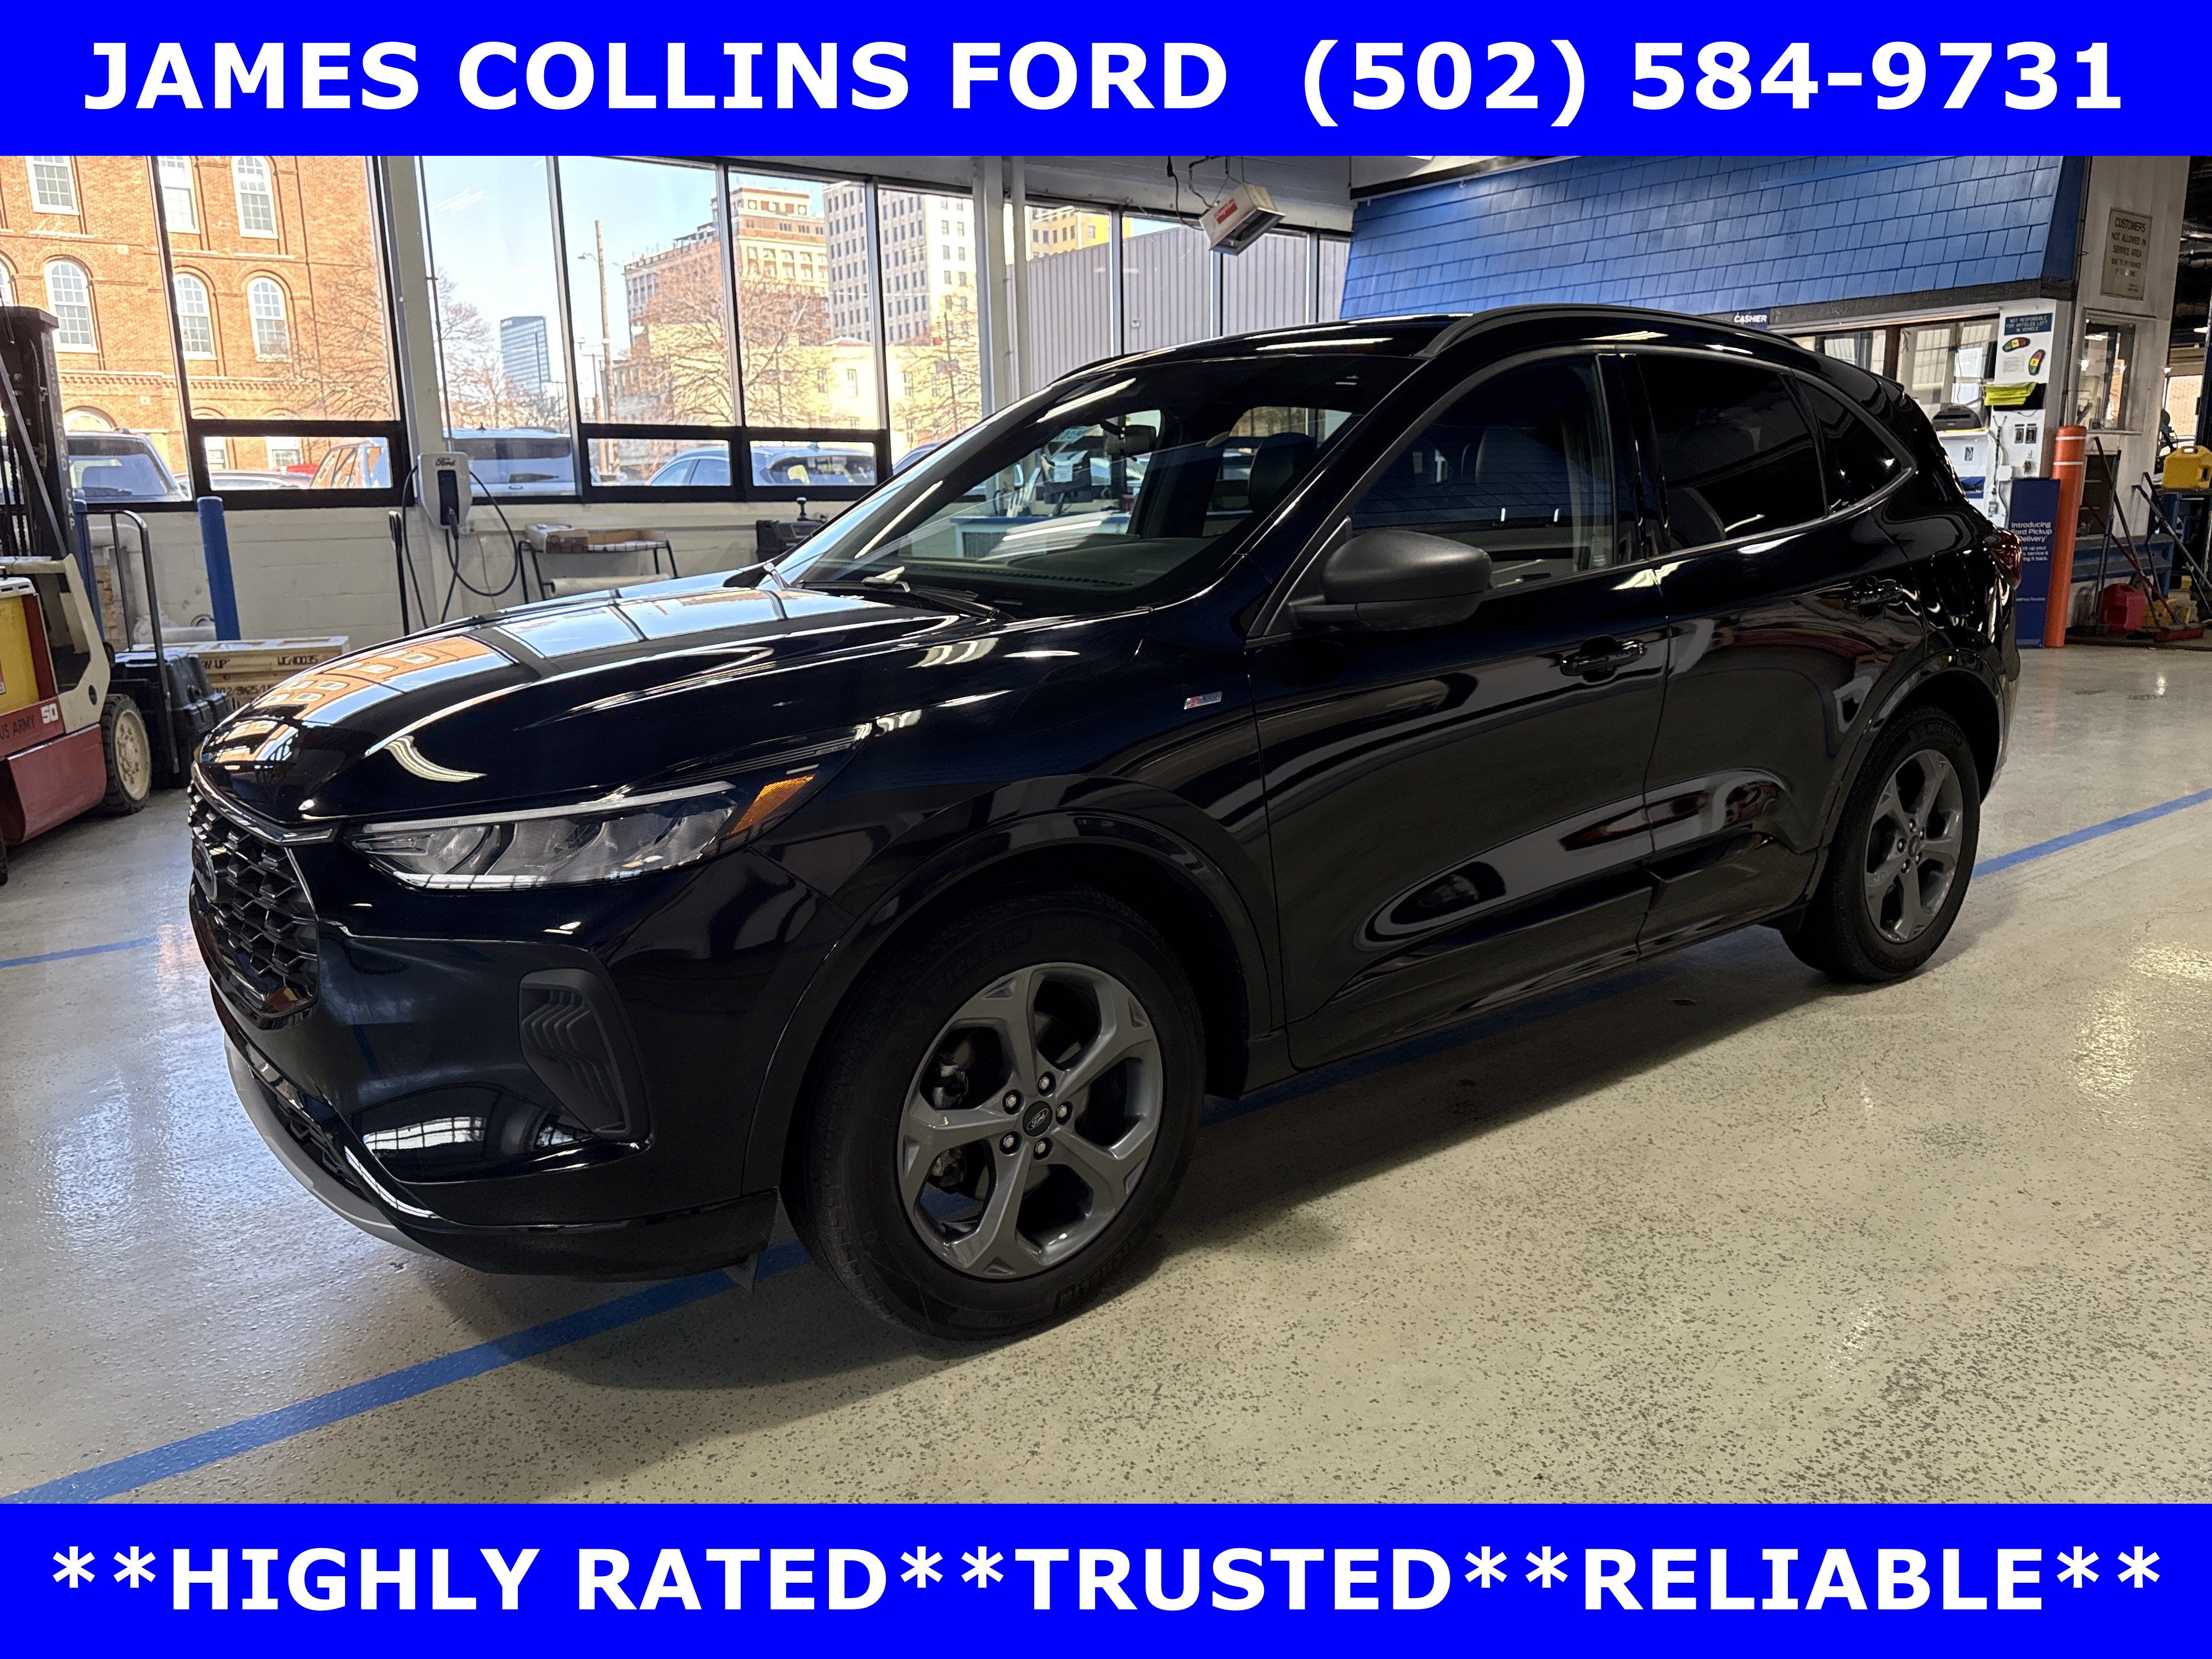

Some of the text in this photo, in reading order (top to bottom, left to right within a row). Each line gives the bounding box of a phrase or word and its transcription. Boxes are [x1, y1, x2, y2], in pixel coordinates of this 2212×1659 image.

[2115, 217, 2146, 233] CUSTOMERS
[2112, 232, 2120, 241] NOT
[1734, 314, 1768, 323] CASHIER
[435, 458, 456, 466] Ford
[66, 488, 76, 531] CAP
[41, 703, 59, 724] 50
[13, 715, 35, 736] ARMY
[1031, 1111, 1045, 1127] Ford
